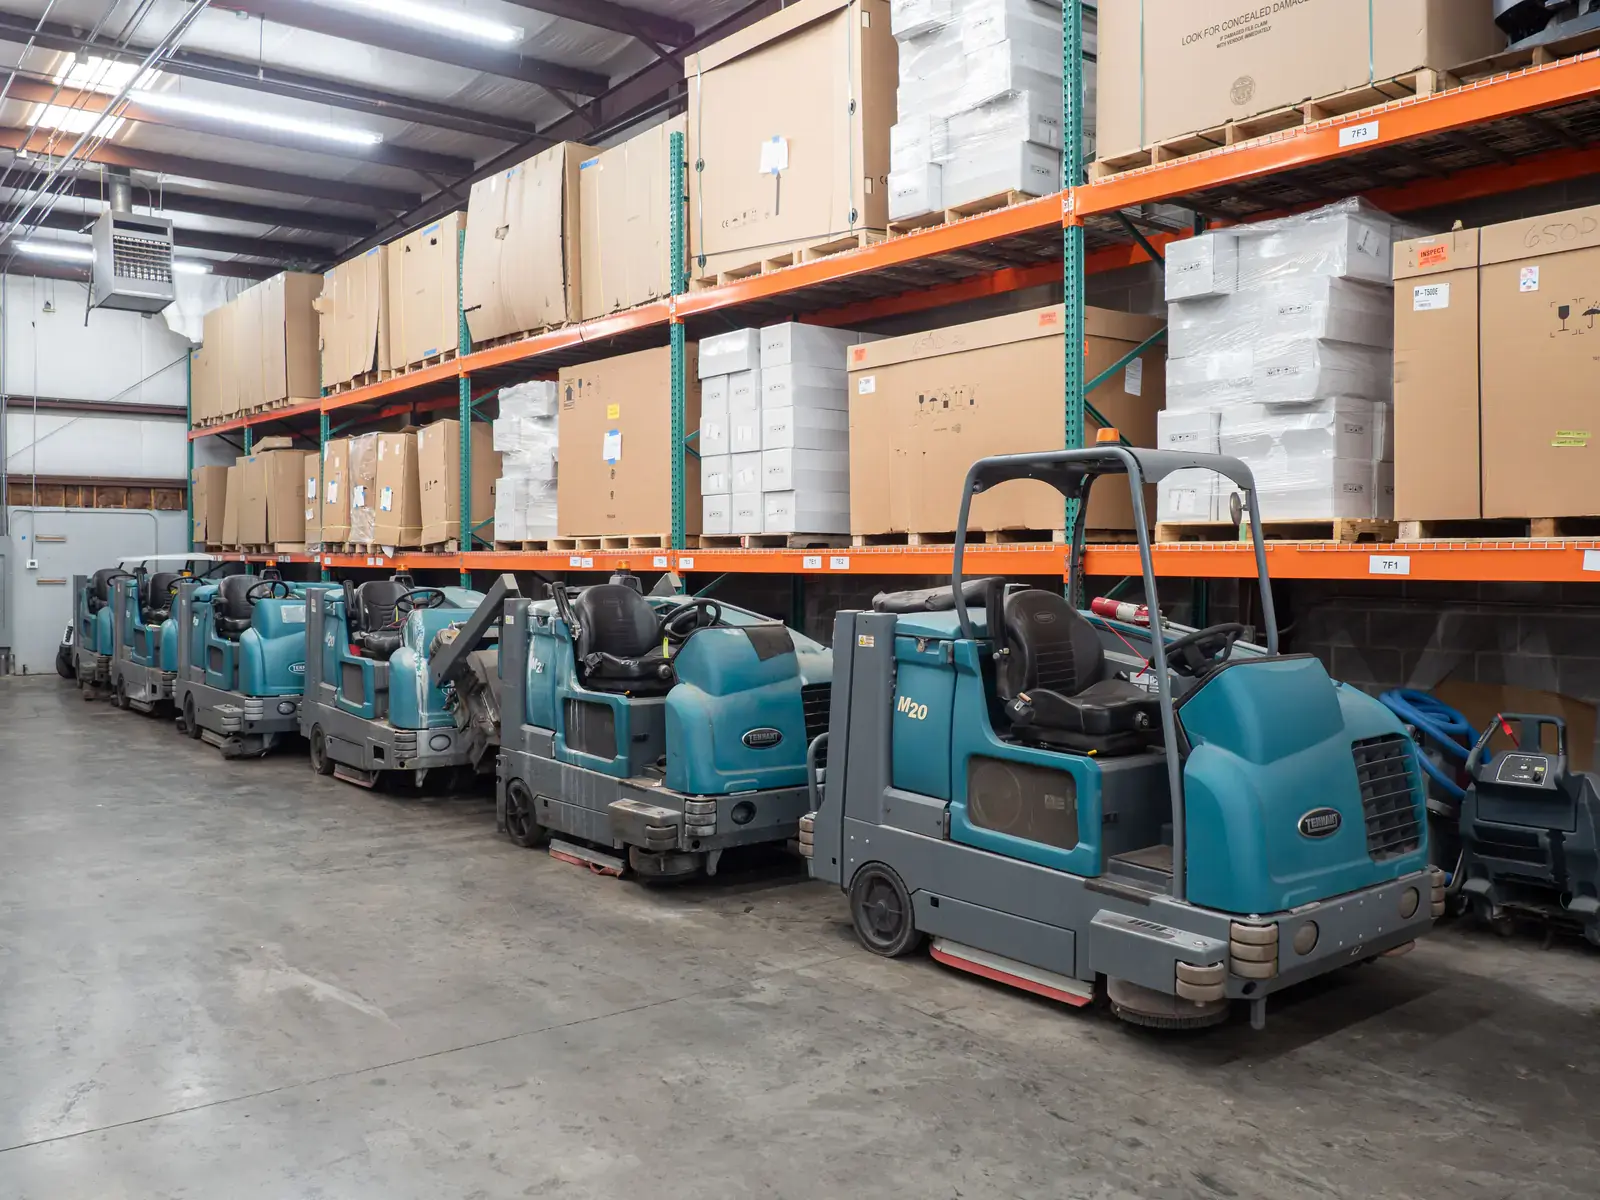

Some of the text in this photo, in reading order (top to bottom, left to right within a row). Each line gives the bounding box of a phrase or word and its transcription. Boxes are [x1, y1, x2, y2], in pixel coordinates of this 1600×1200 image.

[1181, 31, 1203, 46] LOOK
[1203, 24, 1221, 38] FOR
[1221, 5, 1271, 32] CONCEALED
[1351, 129, 1367, 138] 7F3
[1420, 246, 1445, 258] INSPECT
[1382, 561, 1399, 570] 7F1
[897, 695, 928, 720] M20
[1305, 812, 1338, 833] TENNANT
